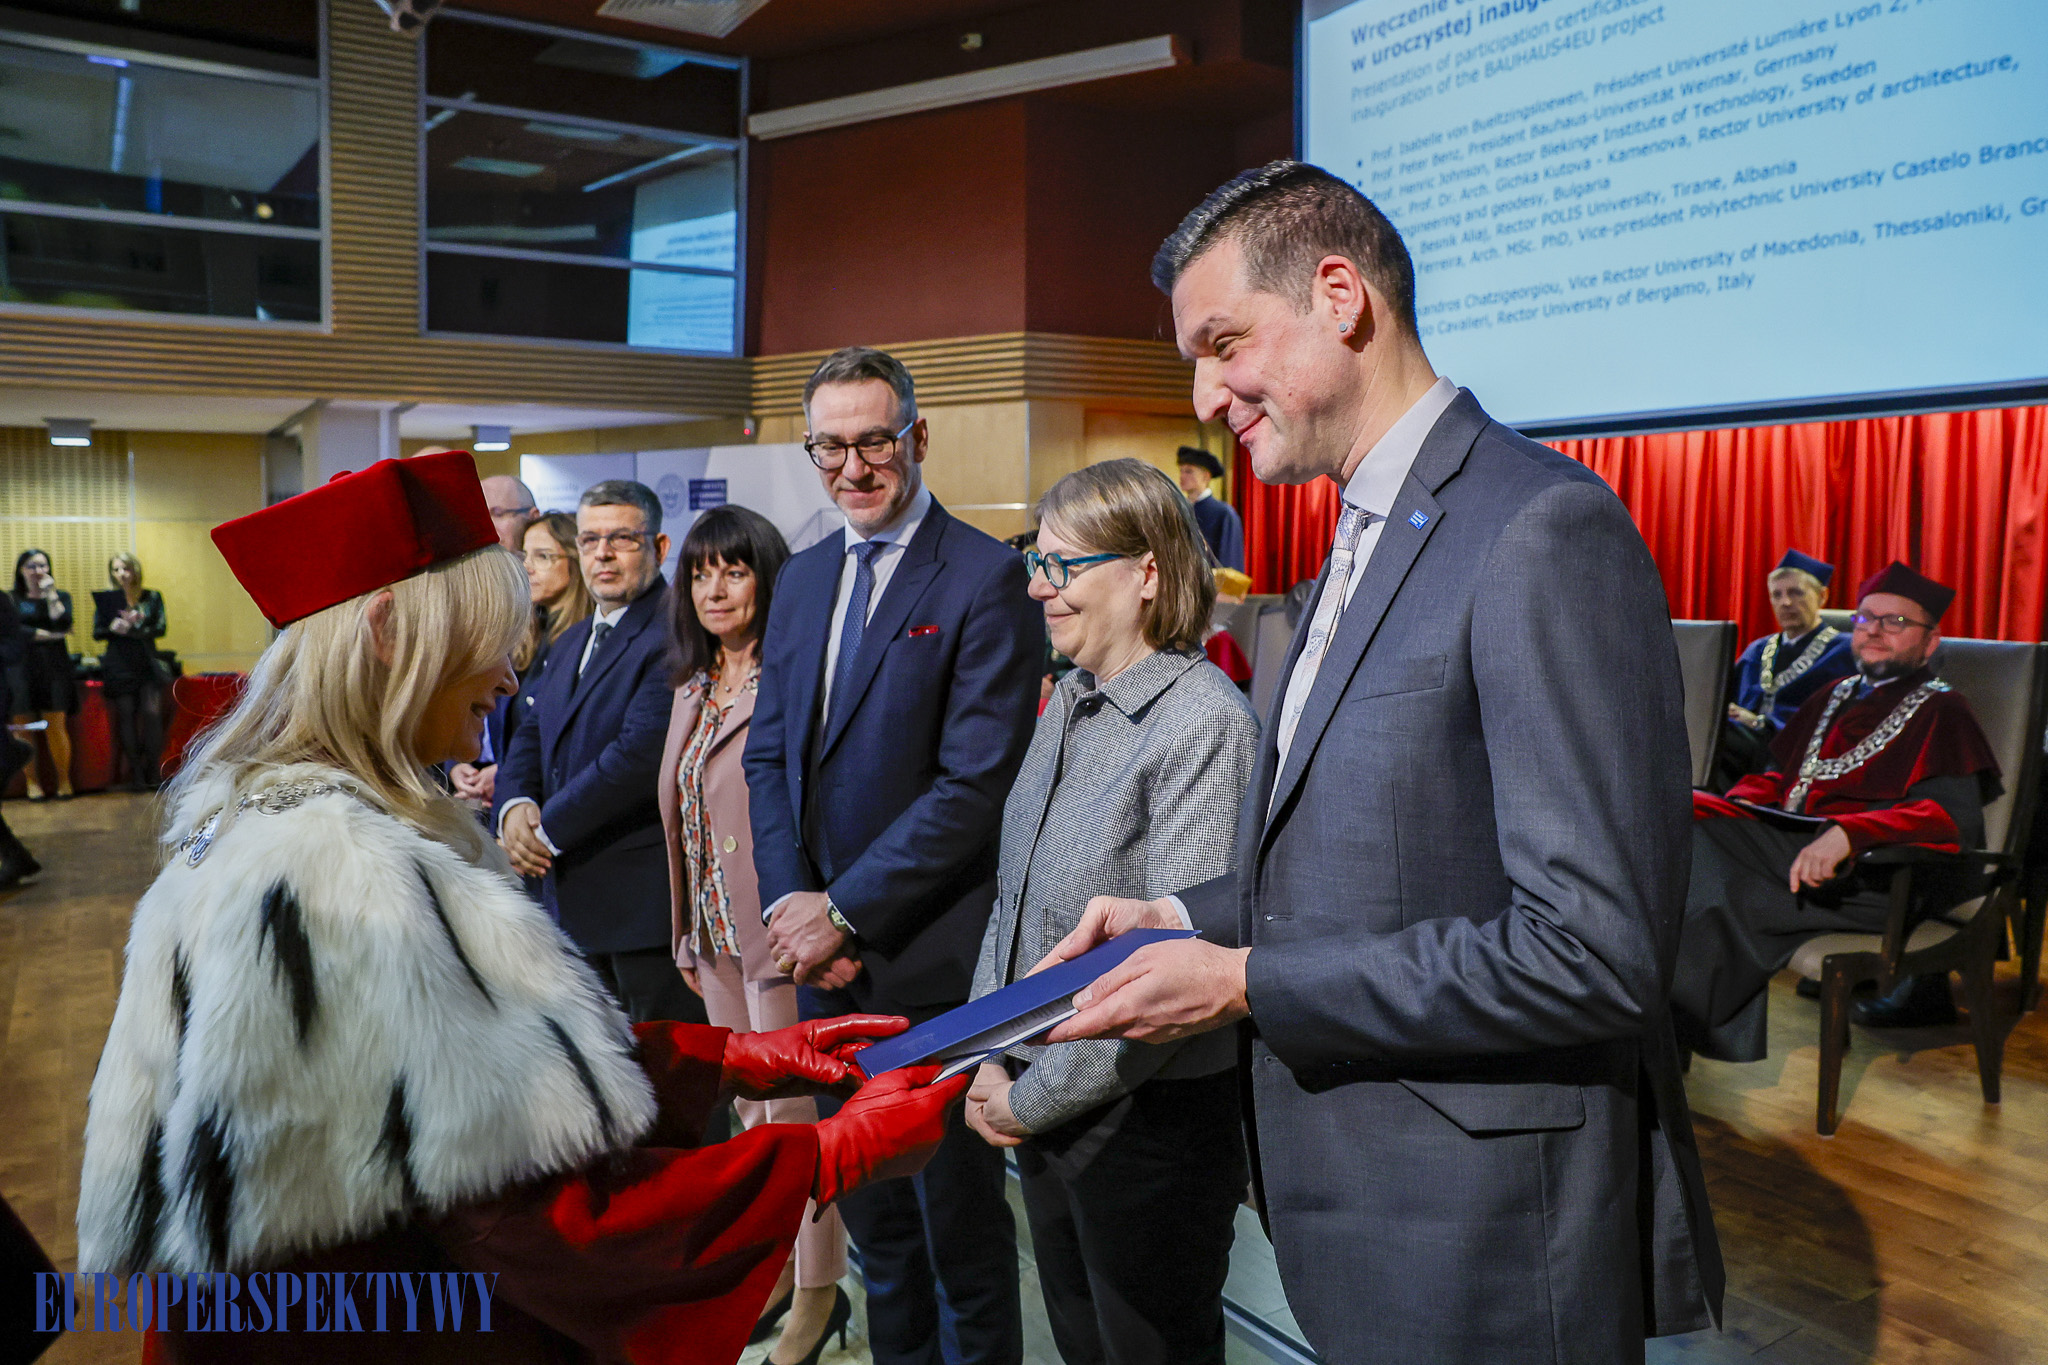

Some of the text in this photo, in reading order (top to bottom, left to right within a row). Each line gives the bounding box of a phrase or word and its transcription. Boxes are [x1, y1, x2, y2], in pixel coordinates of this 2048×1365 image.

[1351, 62, 1432, 101] Presentation
[1436, 51, 1452, 72] of
[1455, 21, 1549, 68] participation
[1352, 0, 1448, 45] Wręczenie
[1352, 56, 1366, 72] w
[1371, 9, 1472, 65] uroczystej
[1436, 74, 1452, 95] of
[1455, 68, 1480, 88] the
[1484, 28, 1595, 78] BAUHAUS4EU
[1601, 5, 1665, 43] project
[1371, 145, 1395, 162] Prof.
[1399, 131, 1443, 155] Isabelle
[1447, 124, 1469, 140] von
[1594, 65, 1661, 97] Président
[1667, 35, 1749, 76] Université
[1755, 18, 1829, 51] Lumière
[1834, 2, 1882, 29] Lyon
[1371, 165, 1395, 183] Prof.
[1399, 158, 1428, 175] Peter
[1432, 149, 1464, 167] Benz,
[1468, 128, 1525, 155] President
[1680, 69, 1748, 97] Weimar,
[1754, 42, 1838, 77] Germany
[1399, 176, 1435, 194] Henric
[1440, 163, 1490, 185] Johnson,
[1494, 150, 1536, 170] Rector
[1540, 133, 1599, 159] Blekinge
[1604, 115, 1667, 143] Institute
[1671, 103, 1688, 125] of
[1693, 83, 1795, 119] Technology,
[1801, 59, 1877, 92] Sweden
[1409, 196, 1434, 213] Prof.
[1495, 171, 1539, 192] Gichka
[1543, 158, 1591, 181] Kutova
[1607, 133, 1692, 164] Kamenova,
[1698, 117, 1752, 143] Rector
[1757, 95, 1849, 129] University
[1855, 82, 1876, 106] of
[1881, 54, 2019, 99] architecture,
[1465, 203, 1488, 222] and
[1491, 192, 1548, 218] geodesy,
[1553, 177, 1611, 201] Bulgaria
[1470, 247, 1501, 263] Arch.
[1541, 231, 1573, 249] PhD,
[1577, 207, 1684, 241] Vice-president
[1690, 188, 1785, 219] Polytechnic
[1790, 168, 1886, 200] University
[1892, 150, 1971, 181] Castelo
[1977, 137, 2048, 165] Branc
[1496, 216, 1538, 235] Rector
[1541, 204, 1583, 226] POLIS
[1587, 190, 1666, 218] University,
[1671, 176, 1728, 198] Tirane,
[1733, 159, 1798, 185] Albania
[1464, 283, 1564, 309] Chatzigeorgiou,
[1567, 274, 1598, 290] Vice
[1602, 266, 1650, 285] Rector
[1655, 250, 1735, 276] University
[1740, 242, 1757, 262] of
[1763, 229, 1866, 258] Macedonia,
[1874, 203, 2012, 239] Thessaloniki,
[1497, 307, 1540, 324] Rector
[1543, 295, 1612, 318] University
[1616, 288, 1633, 306] of
[1636, 281, 1711, 303] Bergamo,
[1717, 271, 1756, 292] Italy
